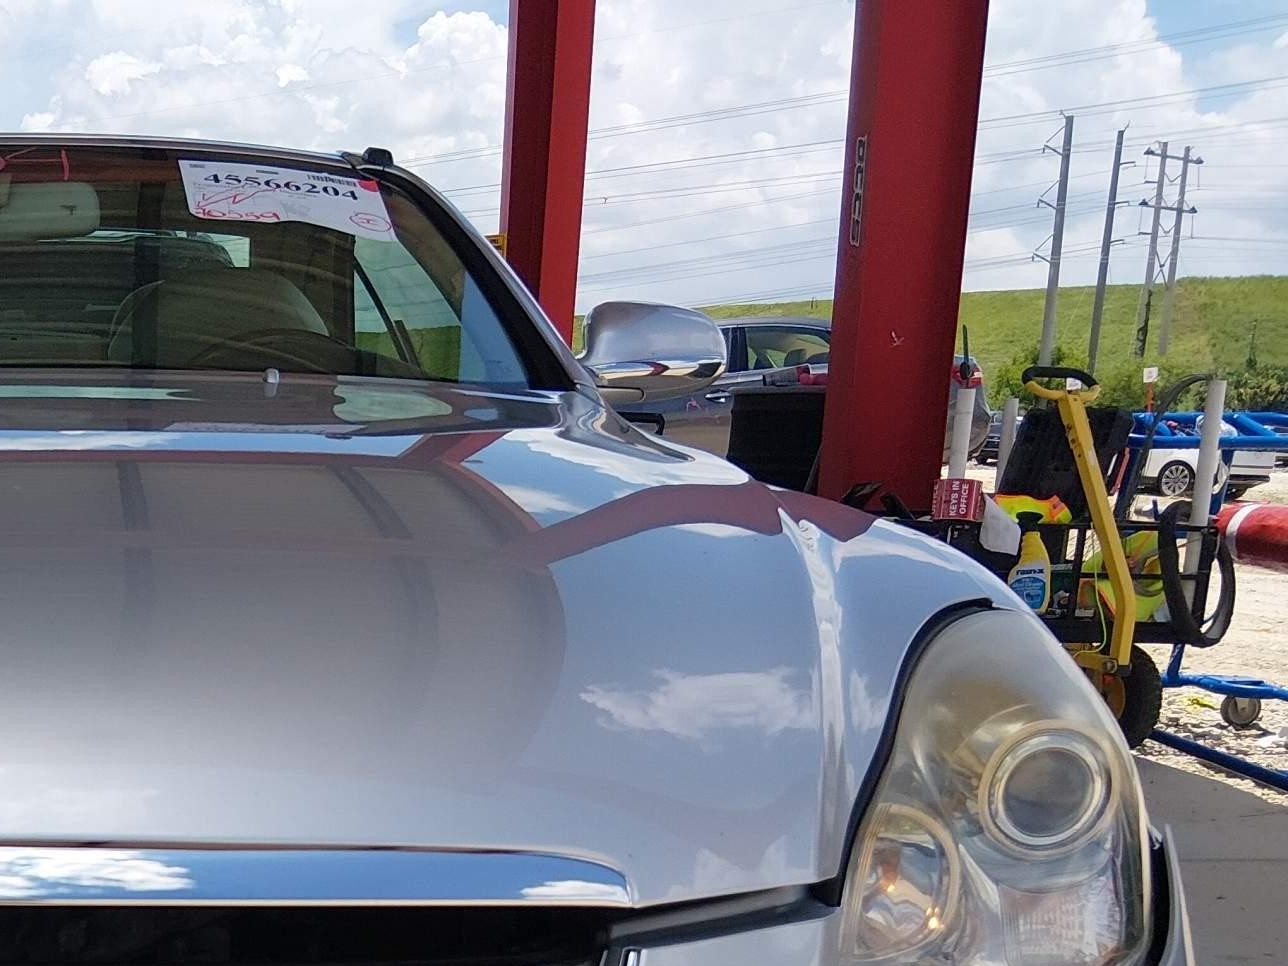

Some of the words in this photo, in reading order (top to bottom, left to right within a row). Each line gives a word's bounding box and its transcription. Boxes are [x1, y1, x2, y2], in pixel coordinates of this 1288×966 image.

[203, 172, 359, 202] 45566204
[952, 480, 961, 491] IN
[959, 483, 969, 515] OFFICE
[949, 492, 959, 516] KEYS
